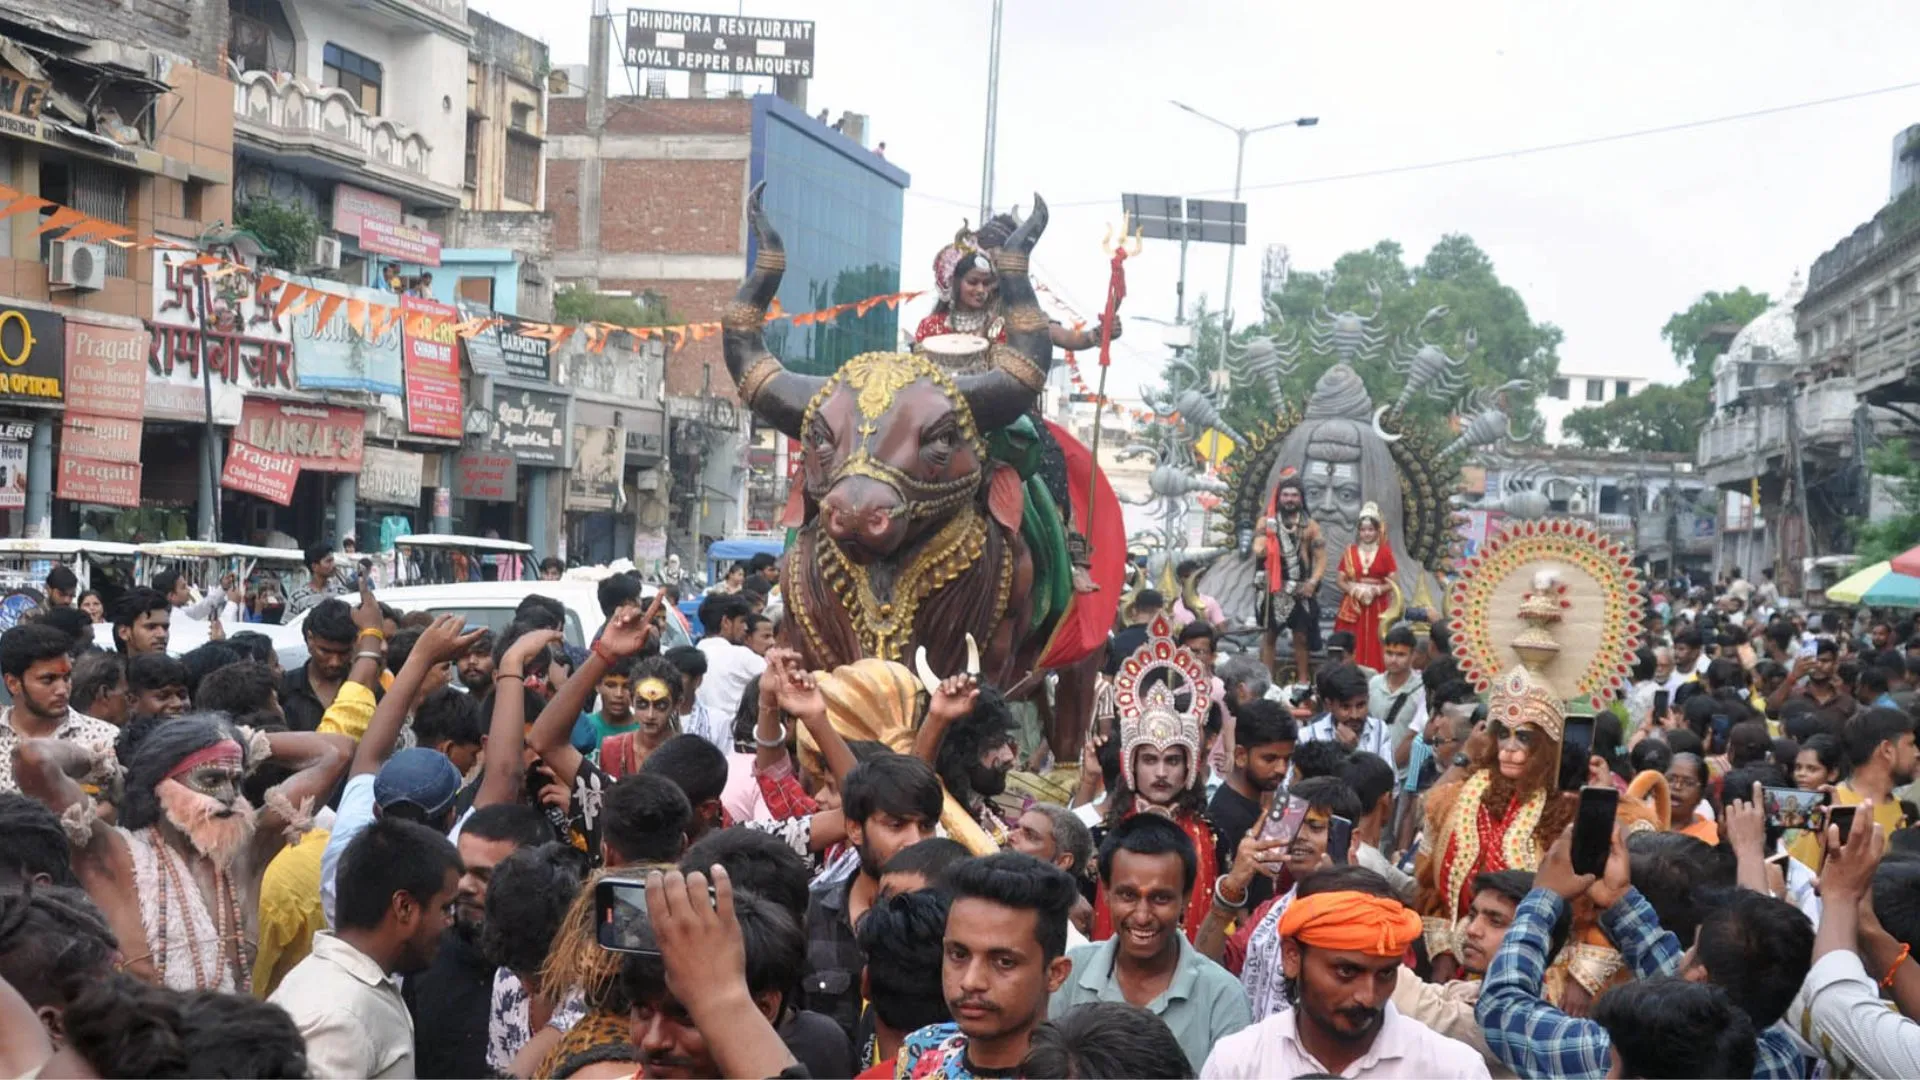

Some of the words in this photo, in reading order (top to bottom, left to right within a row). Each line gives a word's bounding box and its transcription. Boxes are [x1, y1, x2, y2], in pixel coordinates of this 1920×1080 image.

[629, 10, 712, 34] DHINDHORA
[718, 17, 812, 39] RESTAURANT
[712, 37, 727, 50] &
[627, 47, 671, 67] ROYAL
[677, 51, 730, 71] PEPPER
[736, 56, 811, 76] BANQUETS
[75, 331, 143, 366] Pragati
[501, 332, 547, 357] GARMENTS
[9, 372, 63, 398] OPTICAL
[0, 424, 34, 439] LERS
[1, 445, 23, 460] Here
[231, 441, 295, 477] Pragati
[64, 459, 135, 482] Pragati
